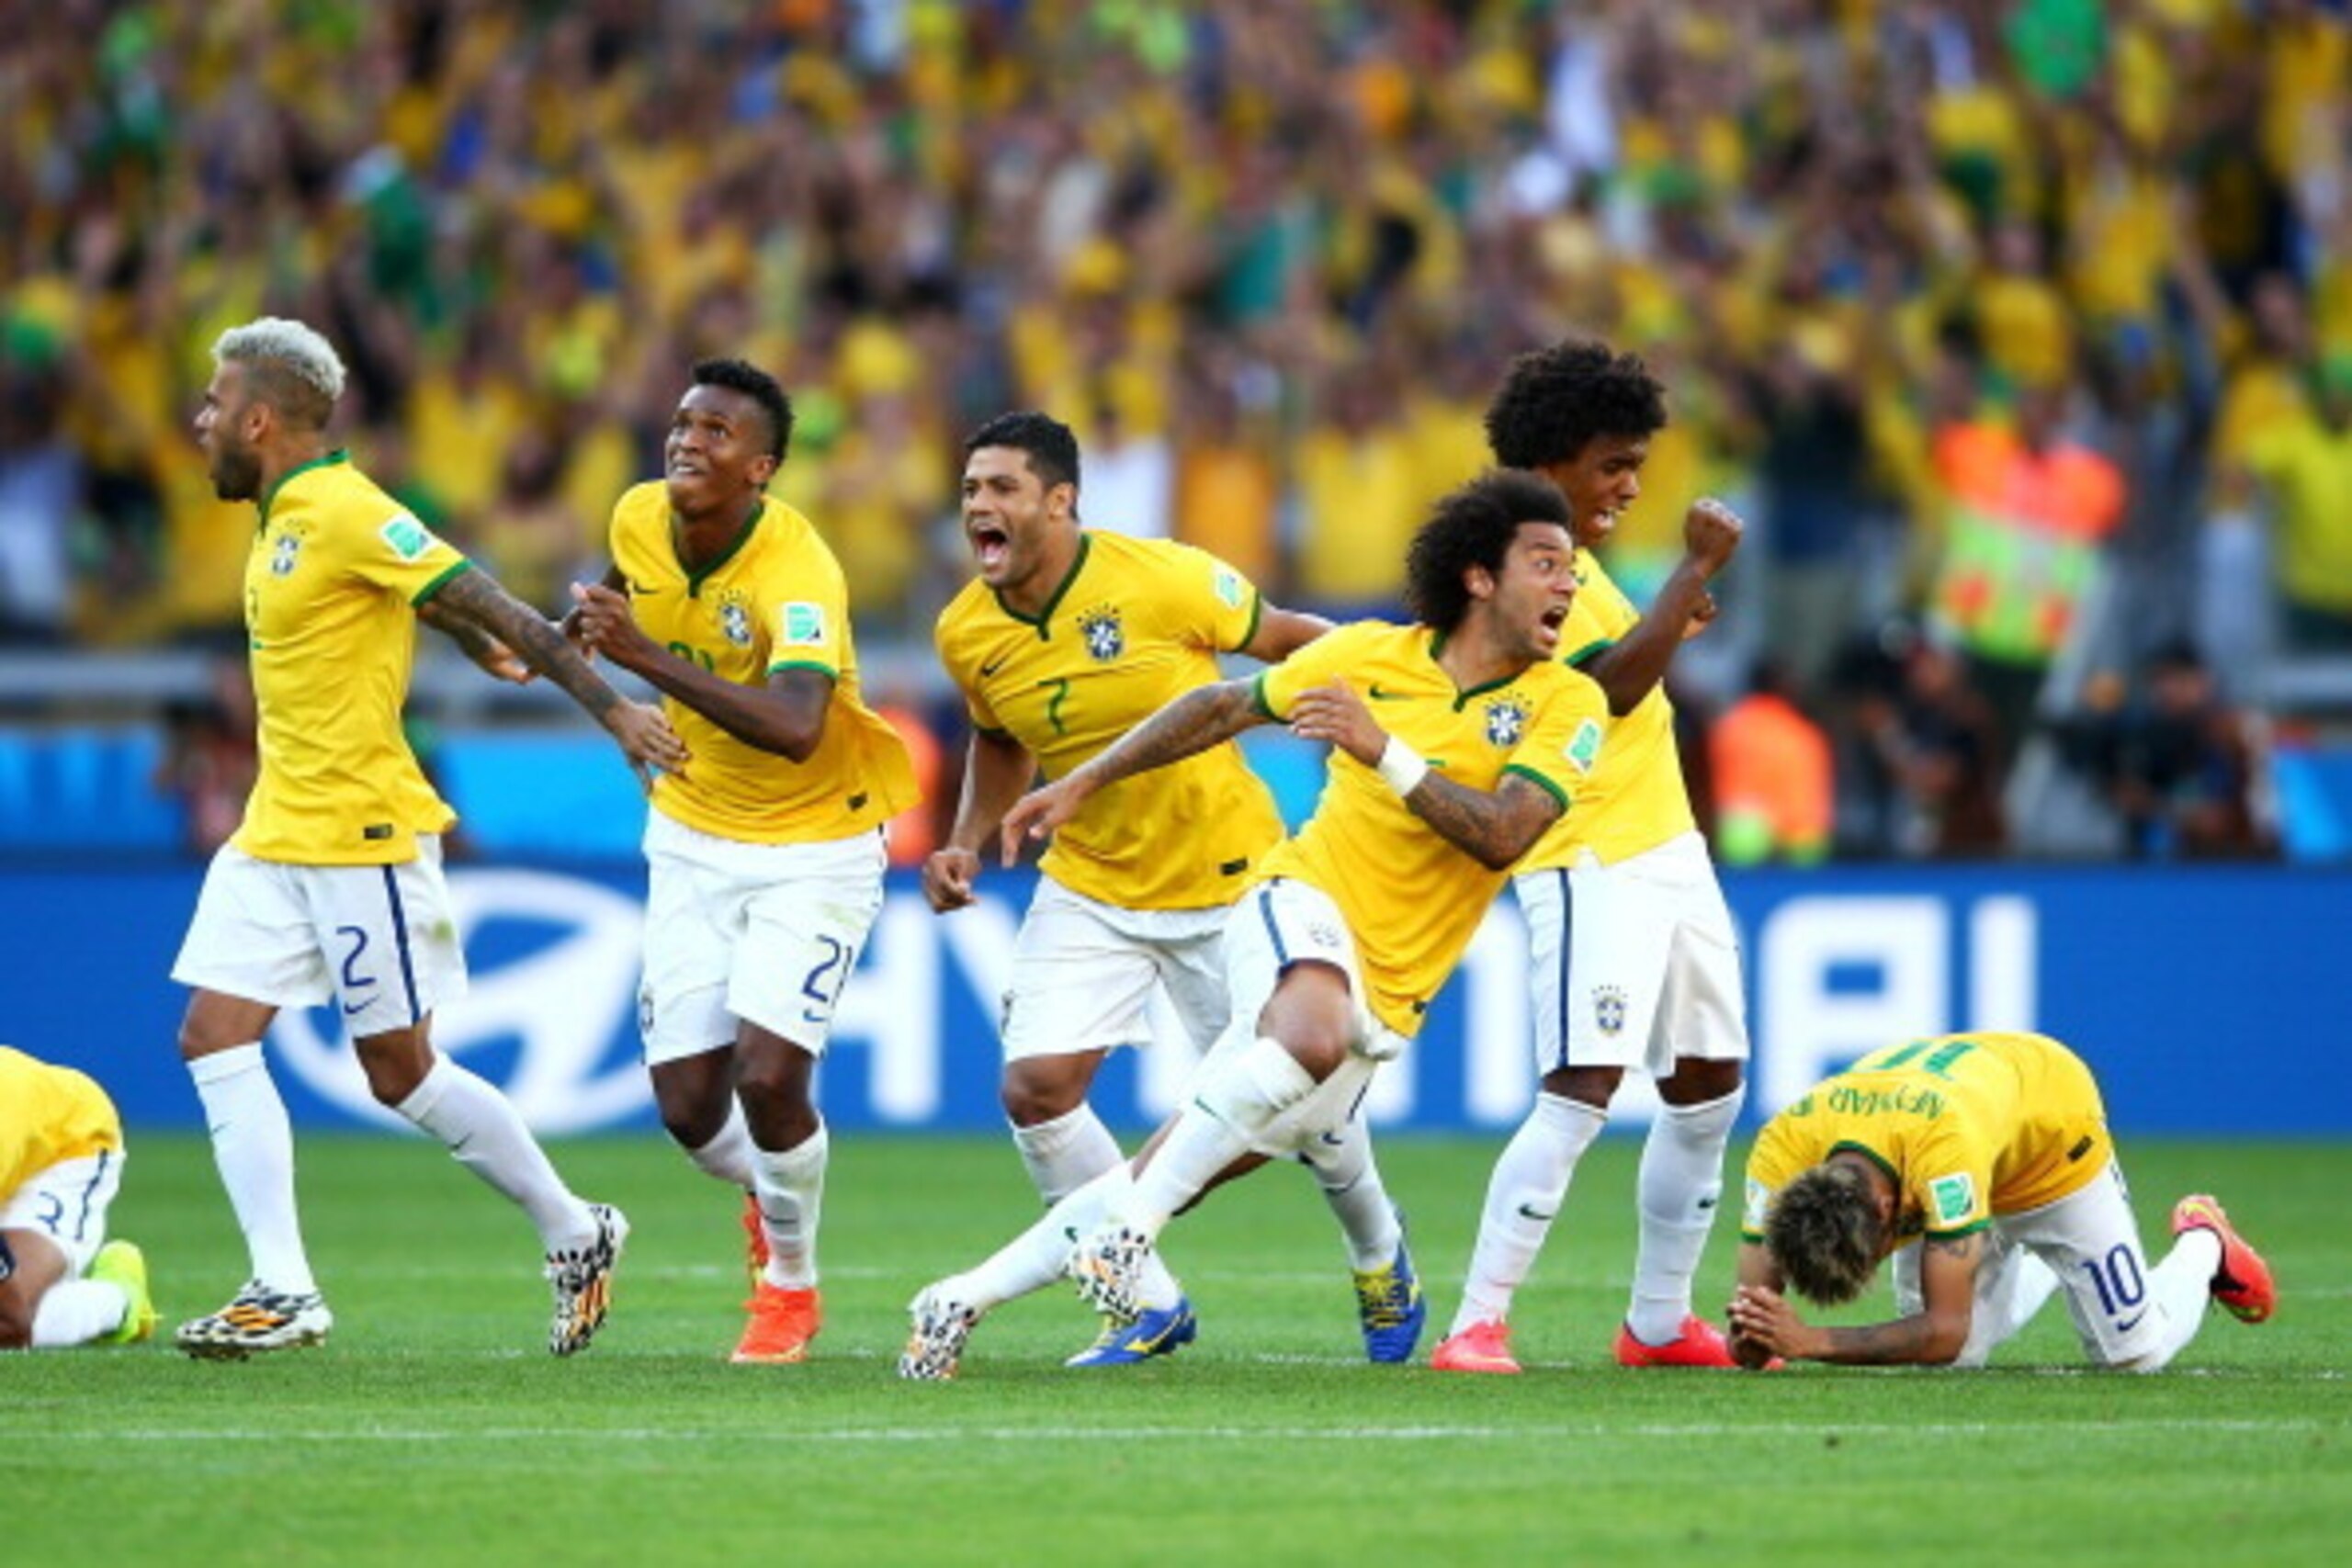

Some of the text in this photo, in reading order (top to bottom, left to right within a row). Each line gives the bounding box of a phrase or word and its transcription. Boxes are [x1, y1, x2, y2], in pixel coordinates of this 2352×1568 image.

[1036, 676, 1070, 736] 7
[335, 925, 377, 988] 2
[802, 933, 853, 1010] 21
[808, 895, 2039, 1123] HNAI
[2080, 1243, 2143, 1314] 10
